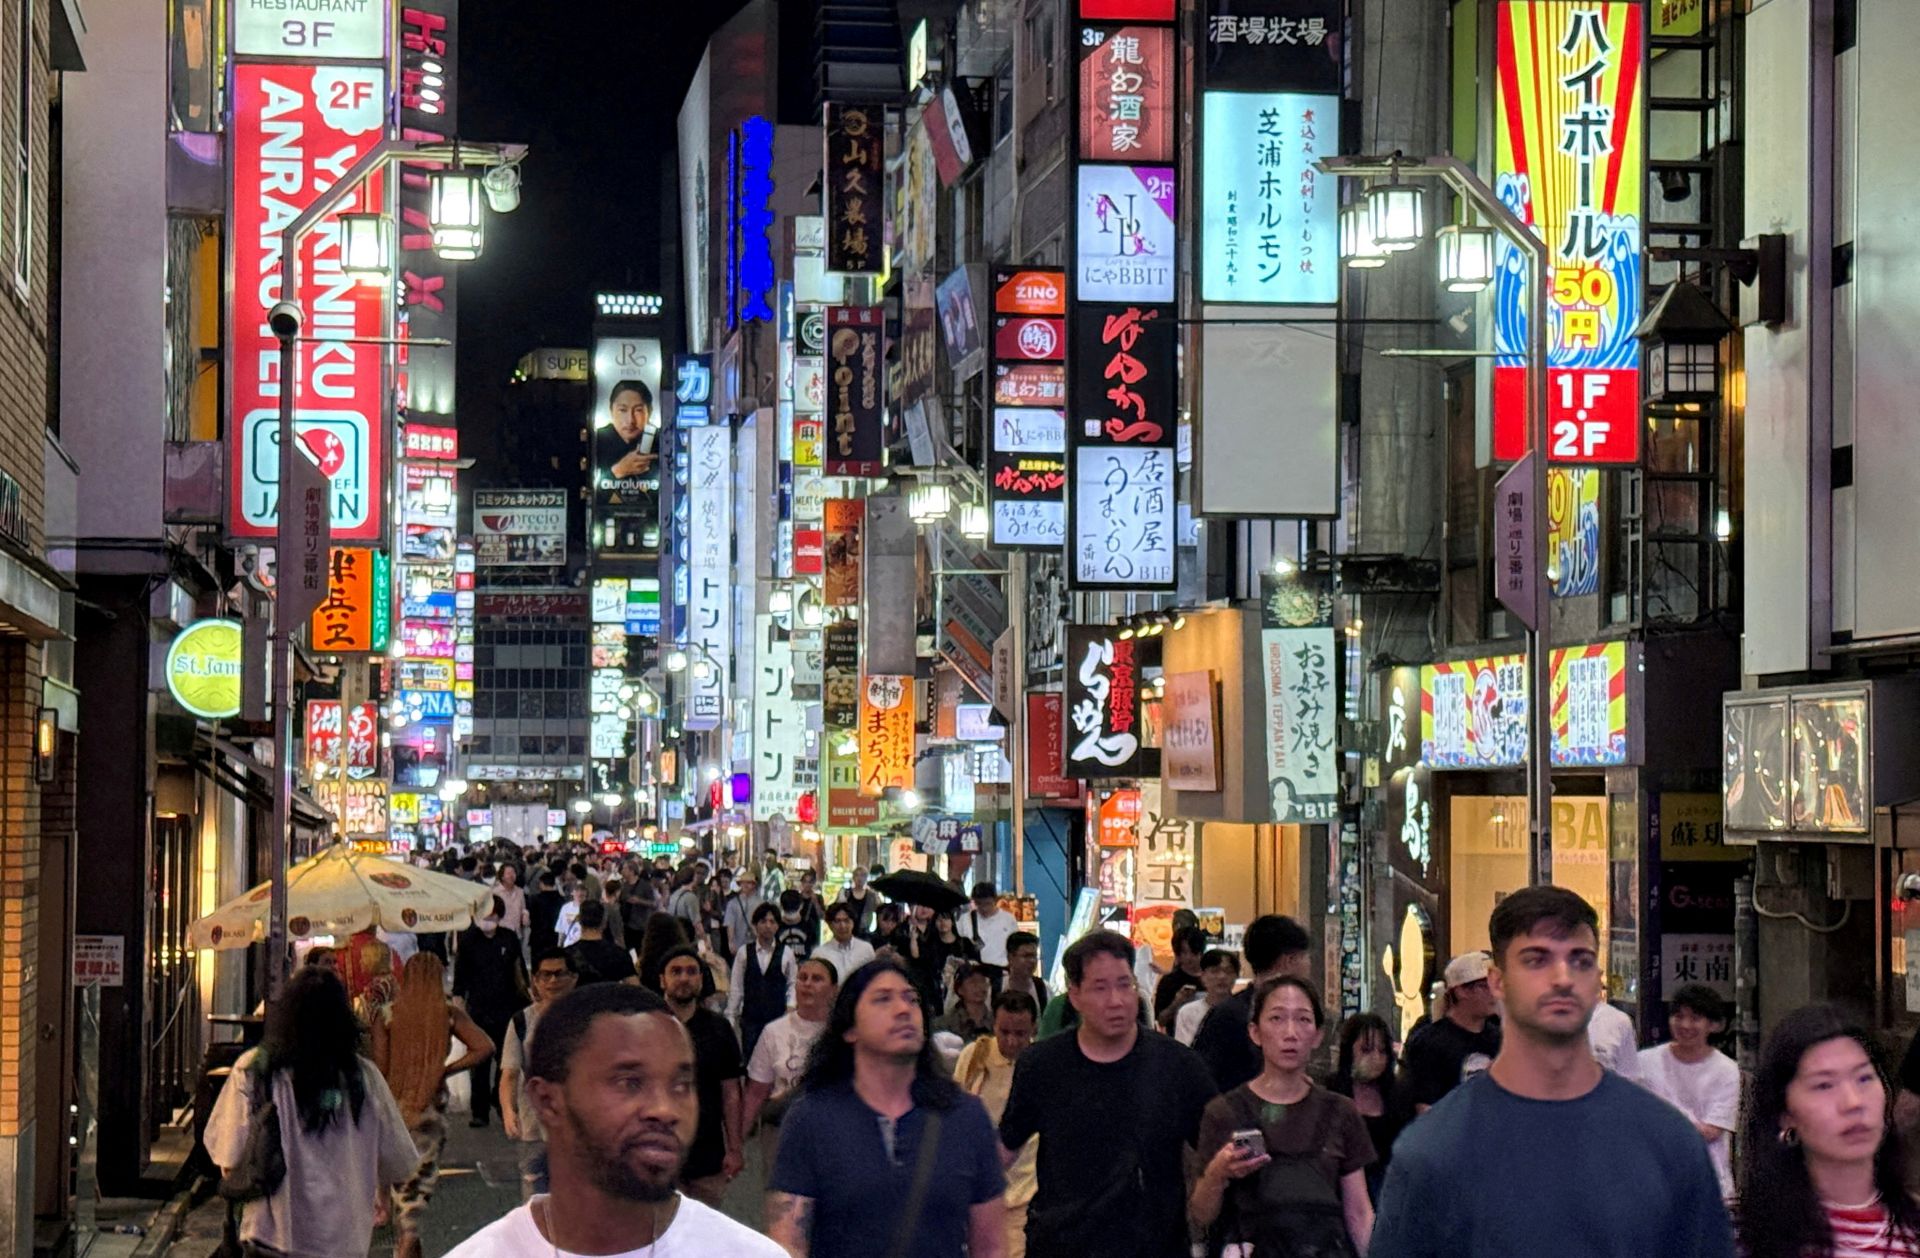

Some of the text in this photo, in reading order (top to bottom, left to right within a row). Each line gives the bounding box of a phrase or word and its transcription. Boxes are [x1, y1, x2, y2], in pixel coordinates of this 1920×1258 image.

[249, 0, 368, 12] RESTAURANT
[281, 20, 335, 47] 3F
[1082, 28, 1105, 47] 3F
[1209, 15, 1328, 46] 酒場牧場
[330, 81, 373, 109] 2F
[1109, 35, 1144, 153] 龍幻酒家
[1560, 9, 1612, 262] ハイボール
[1146, 176, 1174, 200] 2F
[1257, 107, 1284, 284] 芝浦ホルモン
[1015, 286, 1058, 300] ZINO
[1553, 267, 1612, 307] 50
[1563, 309, 1601, 349] 円
[1556, 373, 1610, 409] 1F
[1552, 421, 1611, 457] 2F
[1132, 450, 1168, 553] 居酒屋
[303, 487, 322, 591] 劇場通り一番街
[1508, 492, 1524, 591] 劇場通り一番街
[764, 625, 783, 781] トントン
[1290, 641, 1334, 779] お好み焼き
[866, 710, 891, 787] まっちゃん
